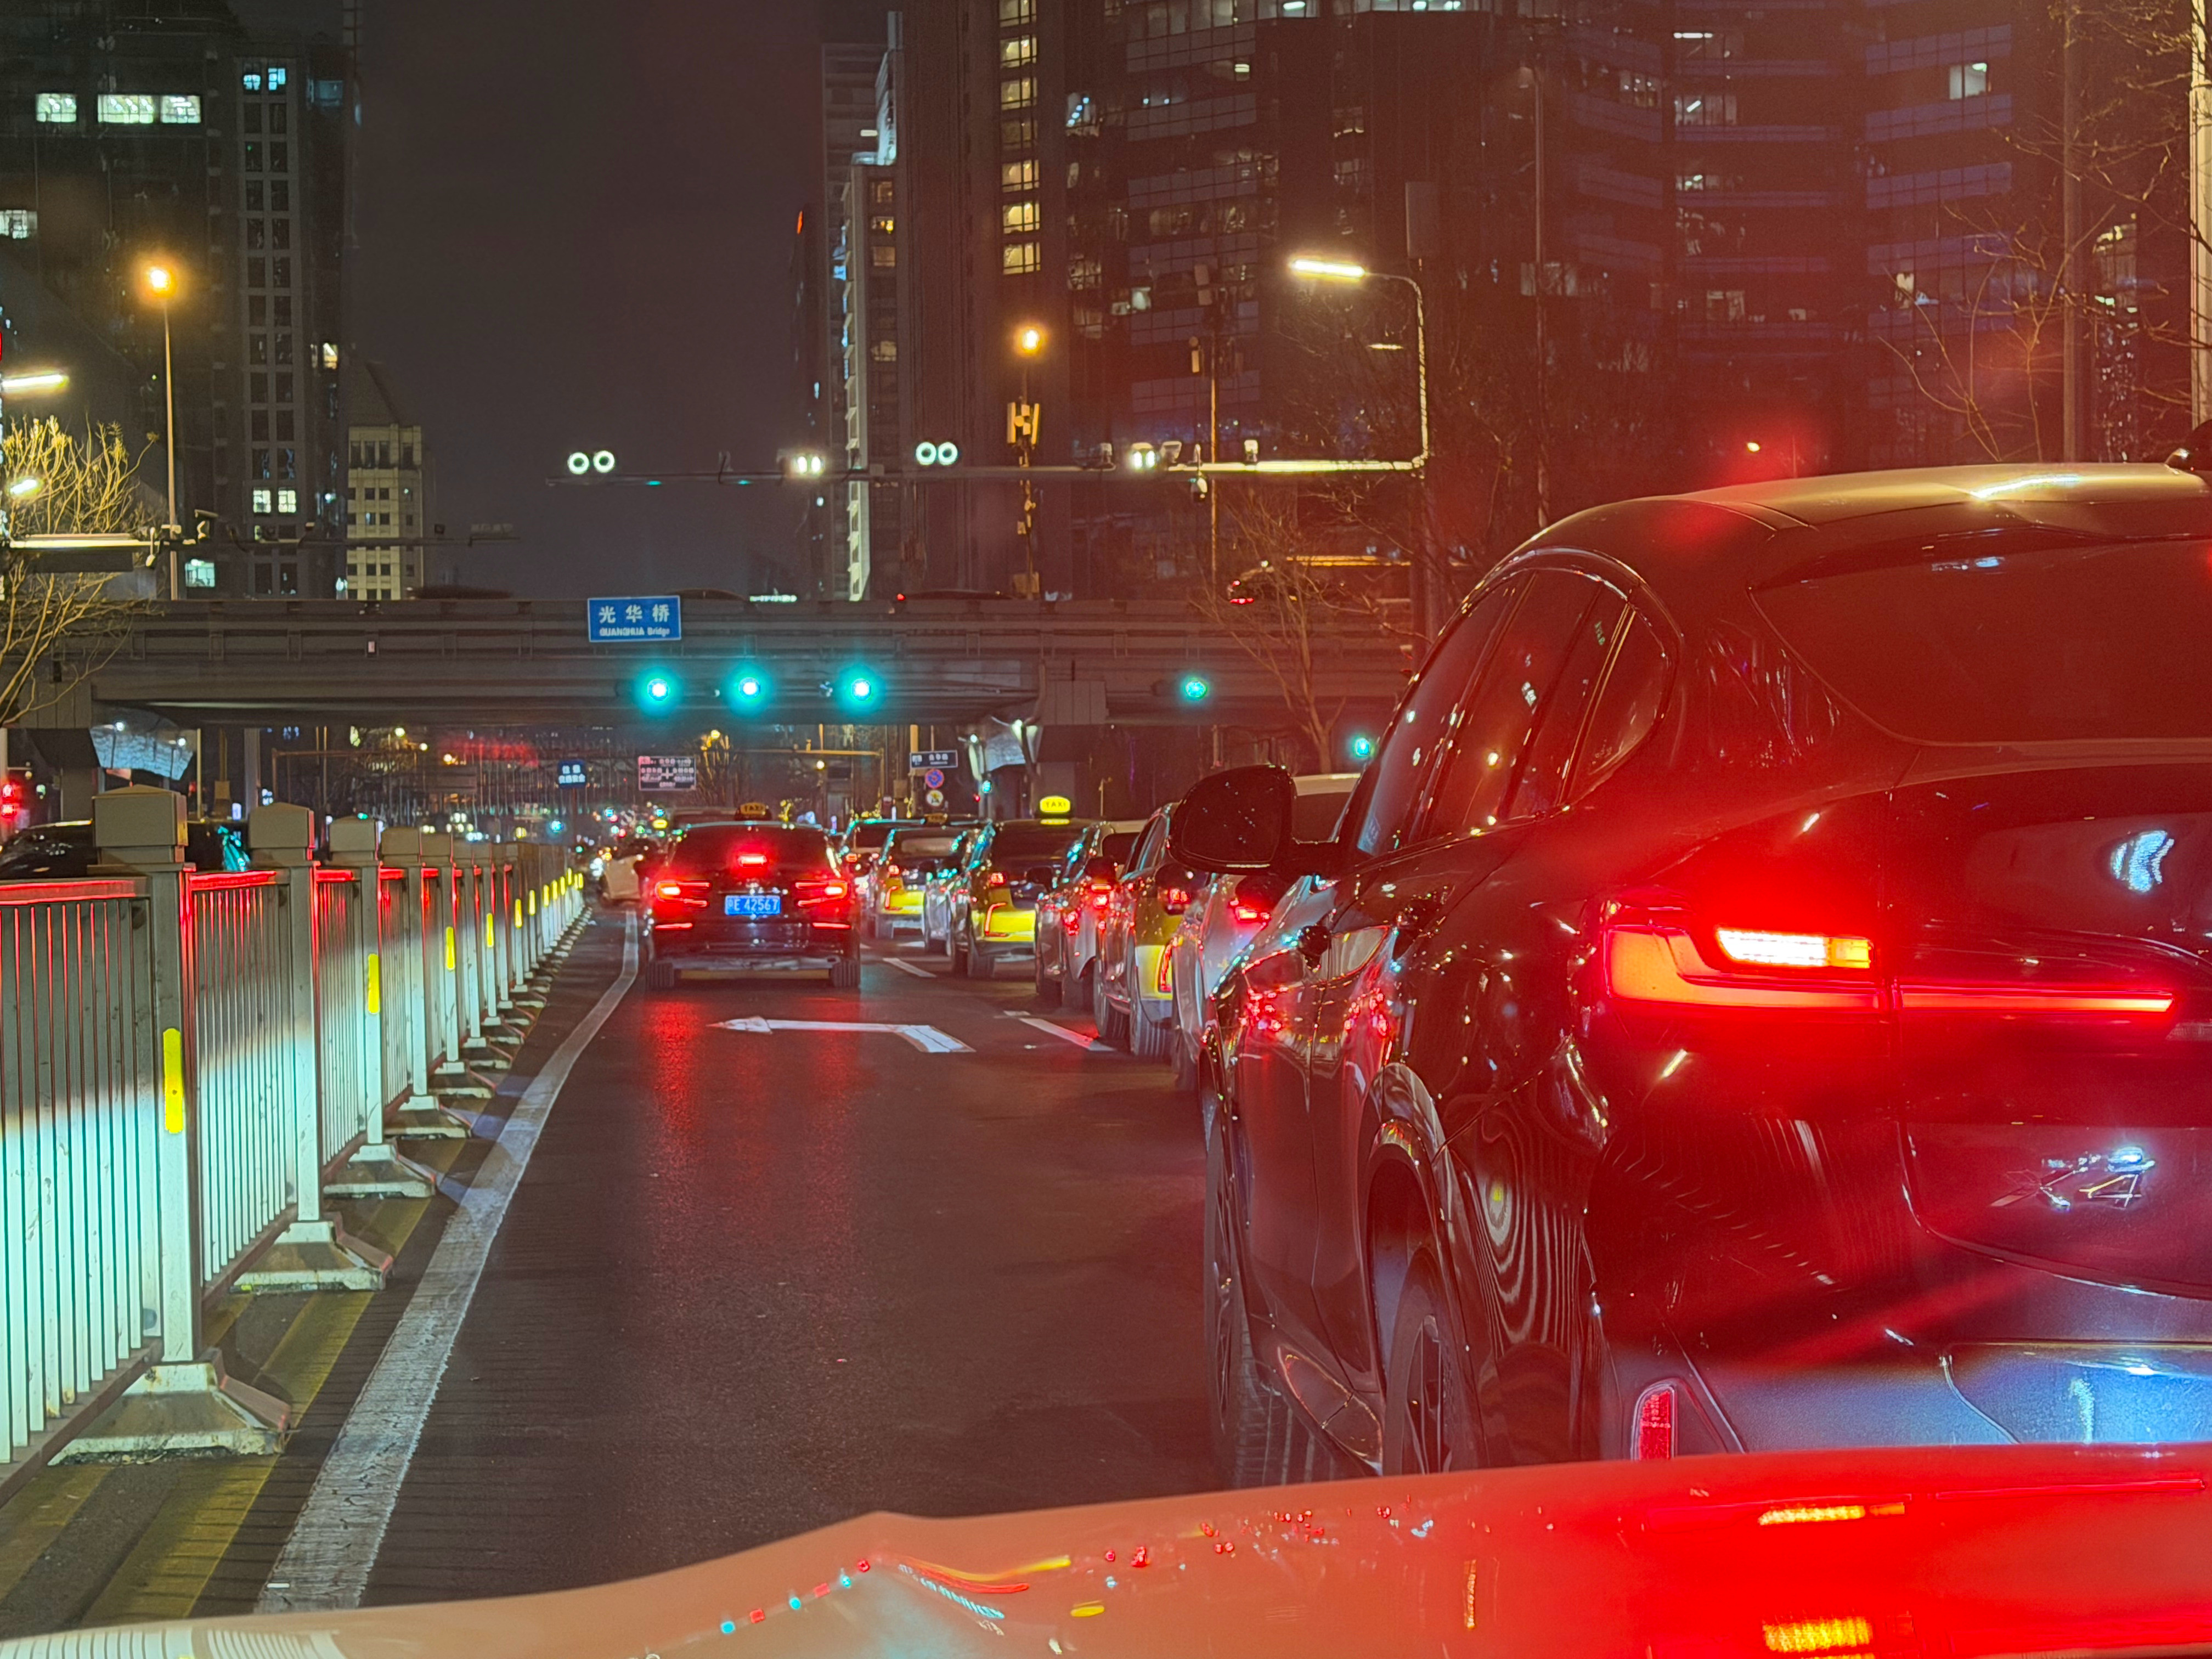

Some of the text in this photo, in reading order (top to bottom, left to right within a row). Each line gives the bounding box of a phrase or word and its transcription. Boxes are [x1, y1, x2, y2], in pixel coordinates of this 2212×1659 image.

[599, 604, 670, 624] 光华桥
[599, 627, 670, 637] GUANGHUA Bridge
[744, 898, 778, 911] 42567
